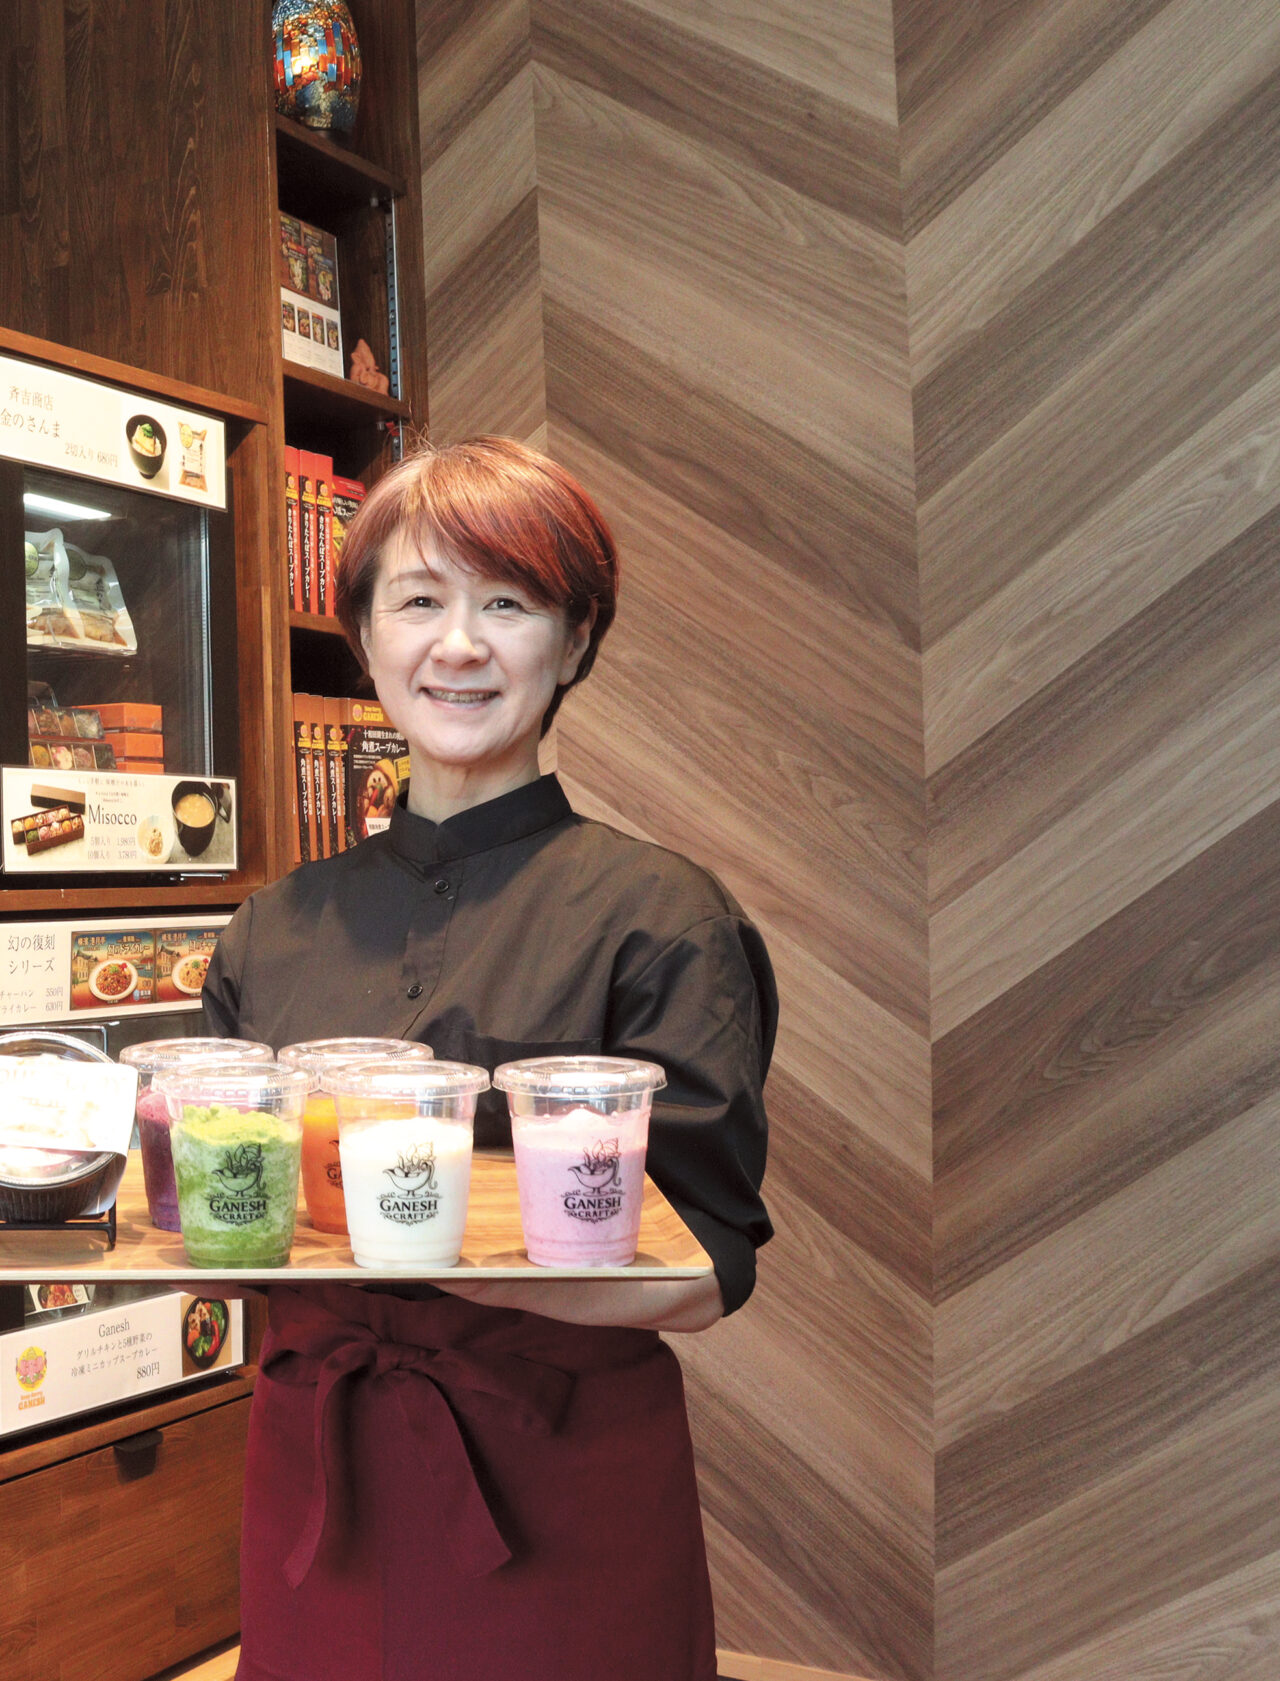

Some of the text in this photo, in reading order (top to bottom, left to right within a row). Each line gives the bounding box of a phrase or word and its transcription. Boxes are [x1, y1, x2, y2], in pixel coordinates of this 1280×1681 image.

[0, 408, 61, 438] 金のさんま
[88, 804, 137, 825] Misocco
[8, 934, 56, 952] 幻の復刻
[9, 957, 55, 975] シリーズ
[209, 1199, 266, 1213] GANESH
[380, 1199, 438, 1212] GANESH
[564, 1196, 621, 1210] GANESH
[393, 1212, 424, 1220] CRAFT
[578, 1210, 609, 1218] CRAFT
[98, 1318, 130, 1338] Ganesh
[136, 1361, 160, 1381] 880円
